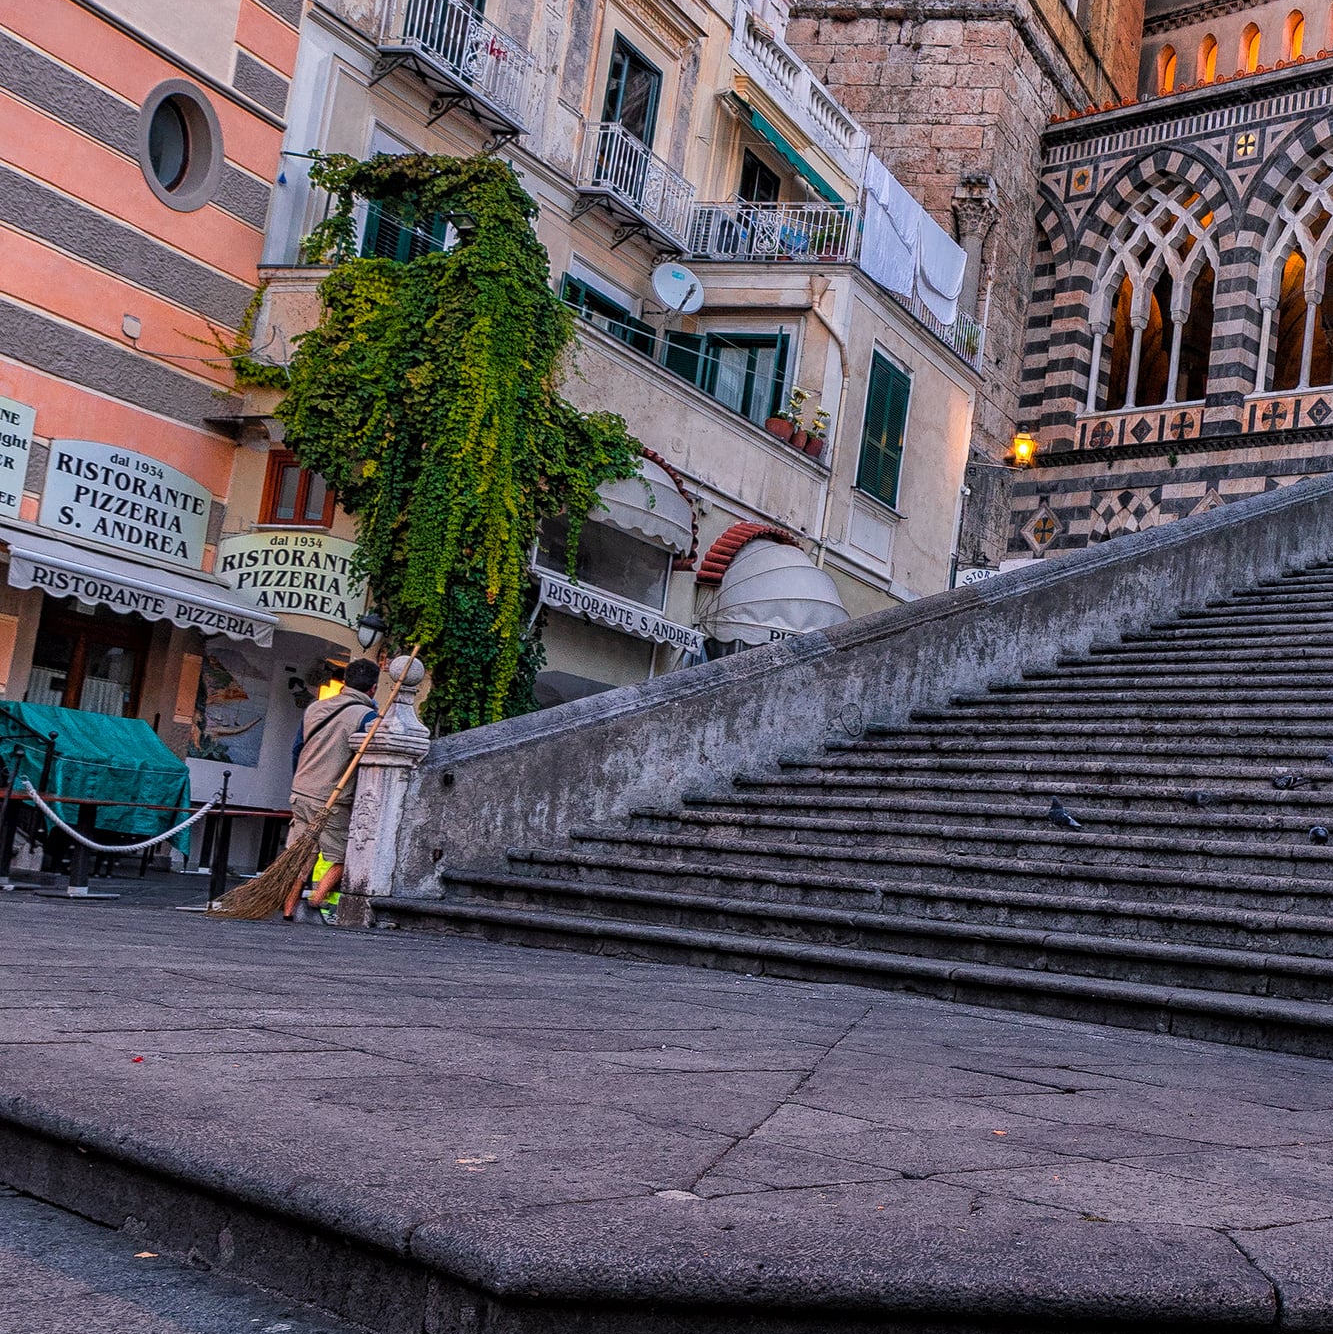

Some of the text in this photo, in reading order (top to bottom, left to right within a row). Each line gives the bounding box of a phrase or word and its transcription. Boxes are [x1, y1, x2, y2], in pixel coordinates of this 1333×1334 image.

[56, 452, 205, 516] RISTORANTE
[110, 453, 165, 480] dal 1934
[74, 484, 182, 534] PIZZERIA
[58, 506, 189, 559] S. ANDREA
[270, 536, 323, 548] dal 1934
[221, 549, 352, 575] RISTORANT
[237, 570, 341, 596] PIZZERIA
[31, 566, 256, 637] RISTORANTE PIZZERIA
[256, 591, 348, 620] ANDREA
[547, 583, 633, 626] RISTORANTE
